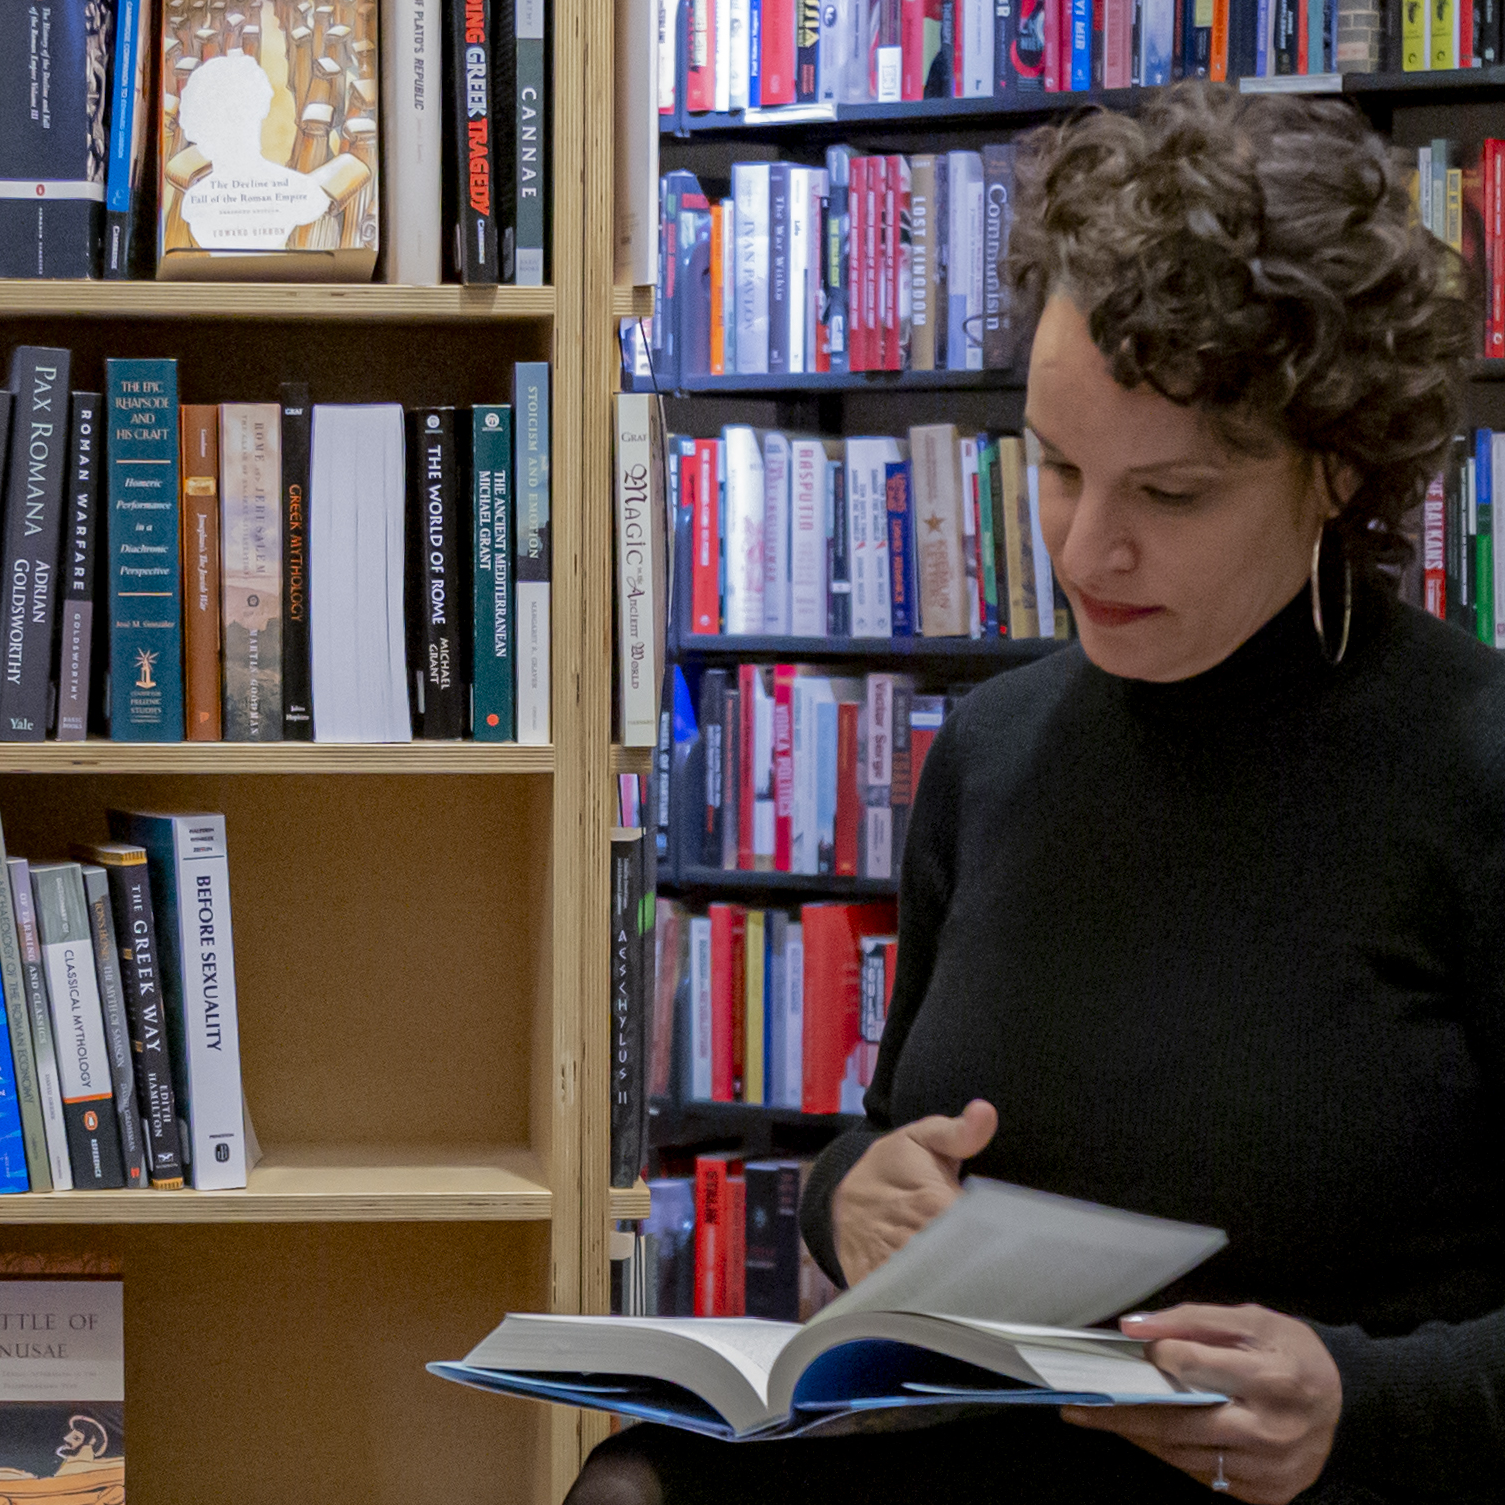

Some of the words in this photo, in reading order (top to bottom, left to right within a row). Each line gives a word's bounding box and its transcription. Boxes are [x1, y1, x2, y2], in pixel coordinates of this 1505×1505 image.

[43, 8, 51, 20] The
[414, 11, 424, 54] PLATO'S
[41, 49, 51, 58] of
[43, 59, 51, 70] the
[414, 58, 424, 110] REPUBLIC
[466, 46, 487, 117] GREEK
[468, 117, 490, 216] TRAGEDY
[521, 87, 537, 198] CANNAE
[210, 180, 228, 189] The
[232, 180, 268, 188] Decline
[272, 179, 288, 188] and
[775, 196, 785, 218] The
[776, 226, 785, 250] War
[915, 196, 927, 238] LOST
[776, 256, 785, 301] Within
[32, 365, 57, 412] PAX
[130, 413, 154, 424] AND
[527, 386, 539, 451] STOICISM
[77, 409, 93, 481] ROMAN
[428, 445, 443, 479] THE
[23, 422, 53, 537] ROMANA
[124, 478, 162, 488] Homeric
[493, 470, 507, 494] THE
[527, 457, 539, 487] AND
[798, 449, 815, 532] RASPUTIN
[116, 500, 171, 511] Performance
[289, 484, 303, 530] GREEK
[428, 484, 443, 547] WORLD
[479, 470, 492, 525] MICHAEL
[73, 494, 89, 591] WARFARE
[494, 497, 506, 549] ANCIENT
[527, 493, 539, 559] EMOTION
[119, 544, 169, 555] Diachronic
[119, 566, 170, 577] Perspective
[430, 552, 444, 573] OF
[479, 528, 491, 571] GRANT
[31, 560, 51, 623] ADRIAN
[290, 535, 303, 622] MYTHOLOGY
[430, 579, 446, 625] ROME
[6, 558, 30, 685] GOLDSWORTHY
[494, 553, 507, 658] MEDITERRANEAN
[70, 613, 81, 701] GOLDSWORTHY
[249, 629, 259, 673] MARTIN
[428, 644, 439, 684] GRANT
[440, 637, 451, 690] MICHAEL
[250, 679, 260, 734] GOODMAN
[776, 704, 792, 754] VODKA
[874, 681, 884, 733] Victor
[874, 738, 884, 780] Serge
[776, 755, 792, 817] POLITICS
[131, 884, 143, 912] THE
[195, 875, 215, 946] BEFORE
[133, 920, 153, 996] GREEK
[65, 949, 81, 1012] CLASSICAL
[73, 1015, 91, 1088] MYTHOLOGY
[201, 952, 221, 1052] SEXUALITY
[143, 1004, 161, 1052] WAY
[148, 1073, 164, 1137] HAMILTON
[159, 1085, 171, 1123] EDITH
[69, 1311, 98, 1331] OF
